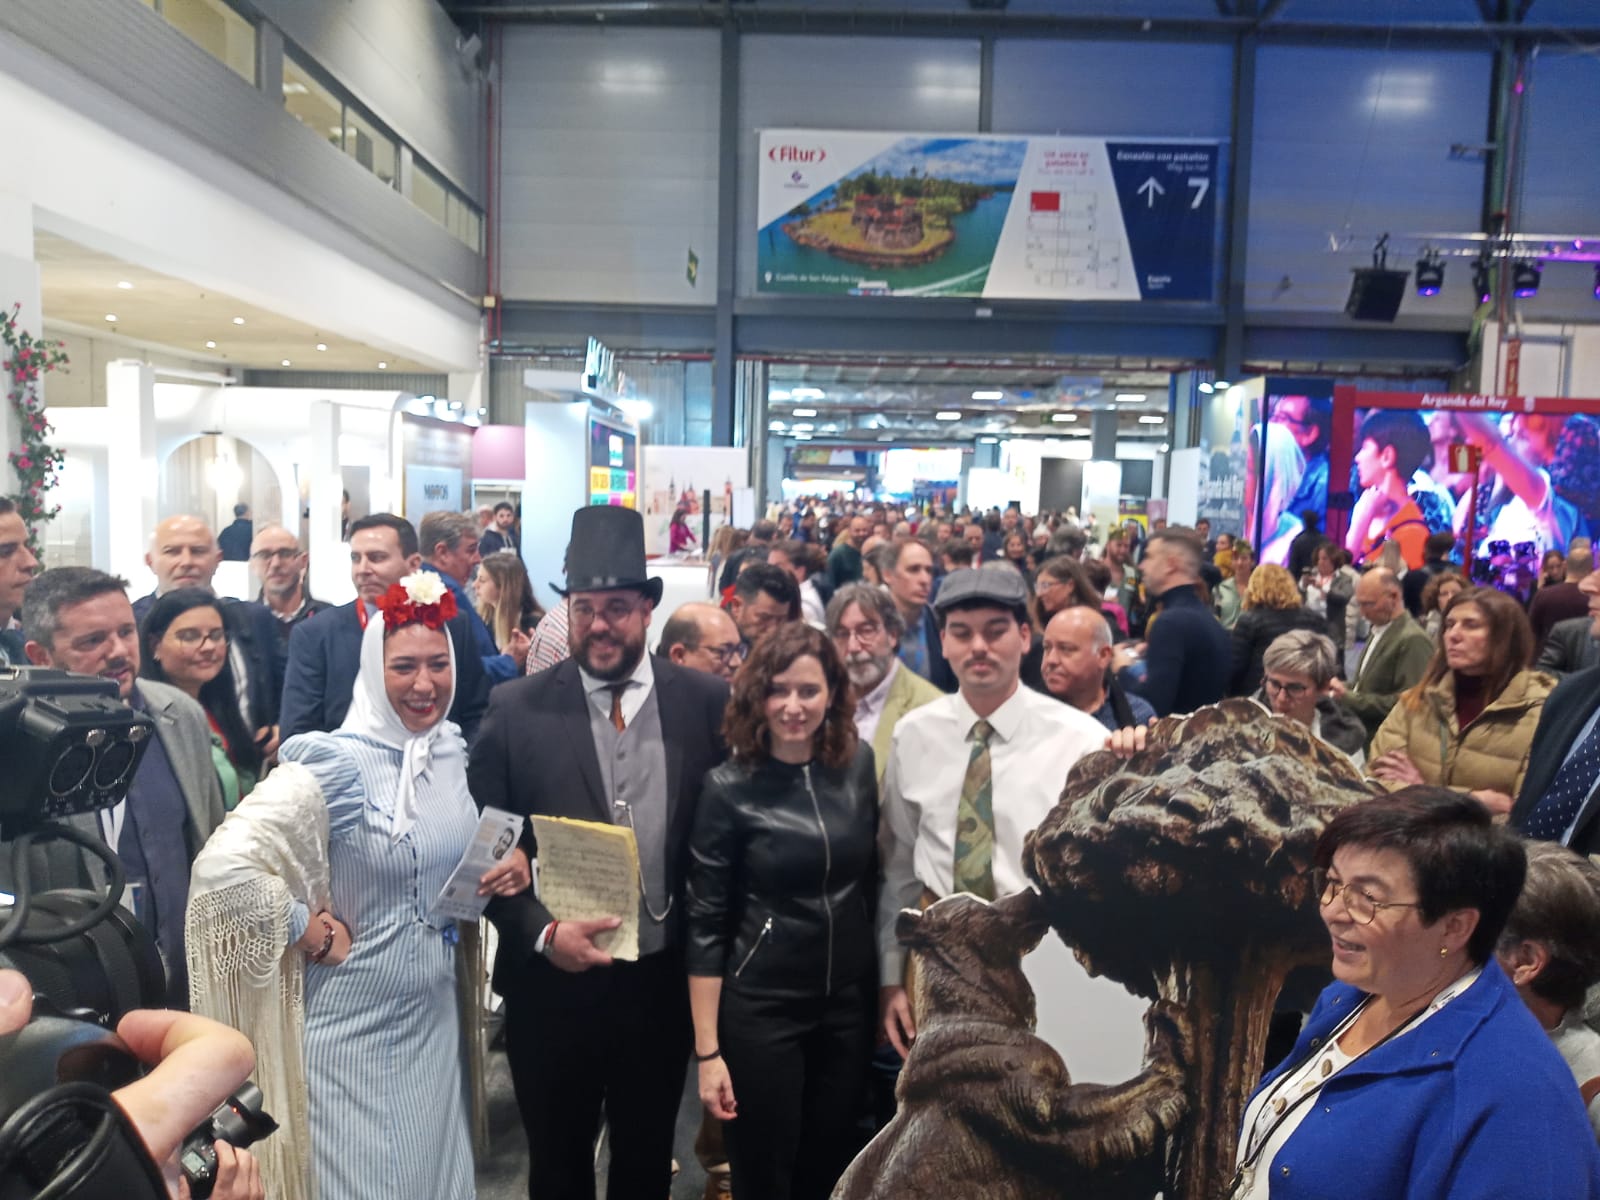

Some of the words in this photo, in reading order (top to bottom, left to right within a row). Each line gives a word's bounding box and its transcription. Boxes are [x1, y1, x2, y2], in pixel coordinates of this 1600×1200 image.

[1187, 177, 1210, 209] 7
[1421, 394, 1467, 408] Arganda
[1469, 395, 1486, 406] del
[1487, 396, 1509, 409] Rey
